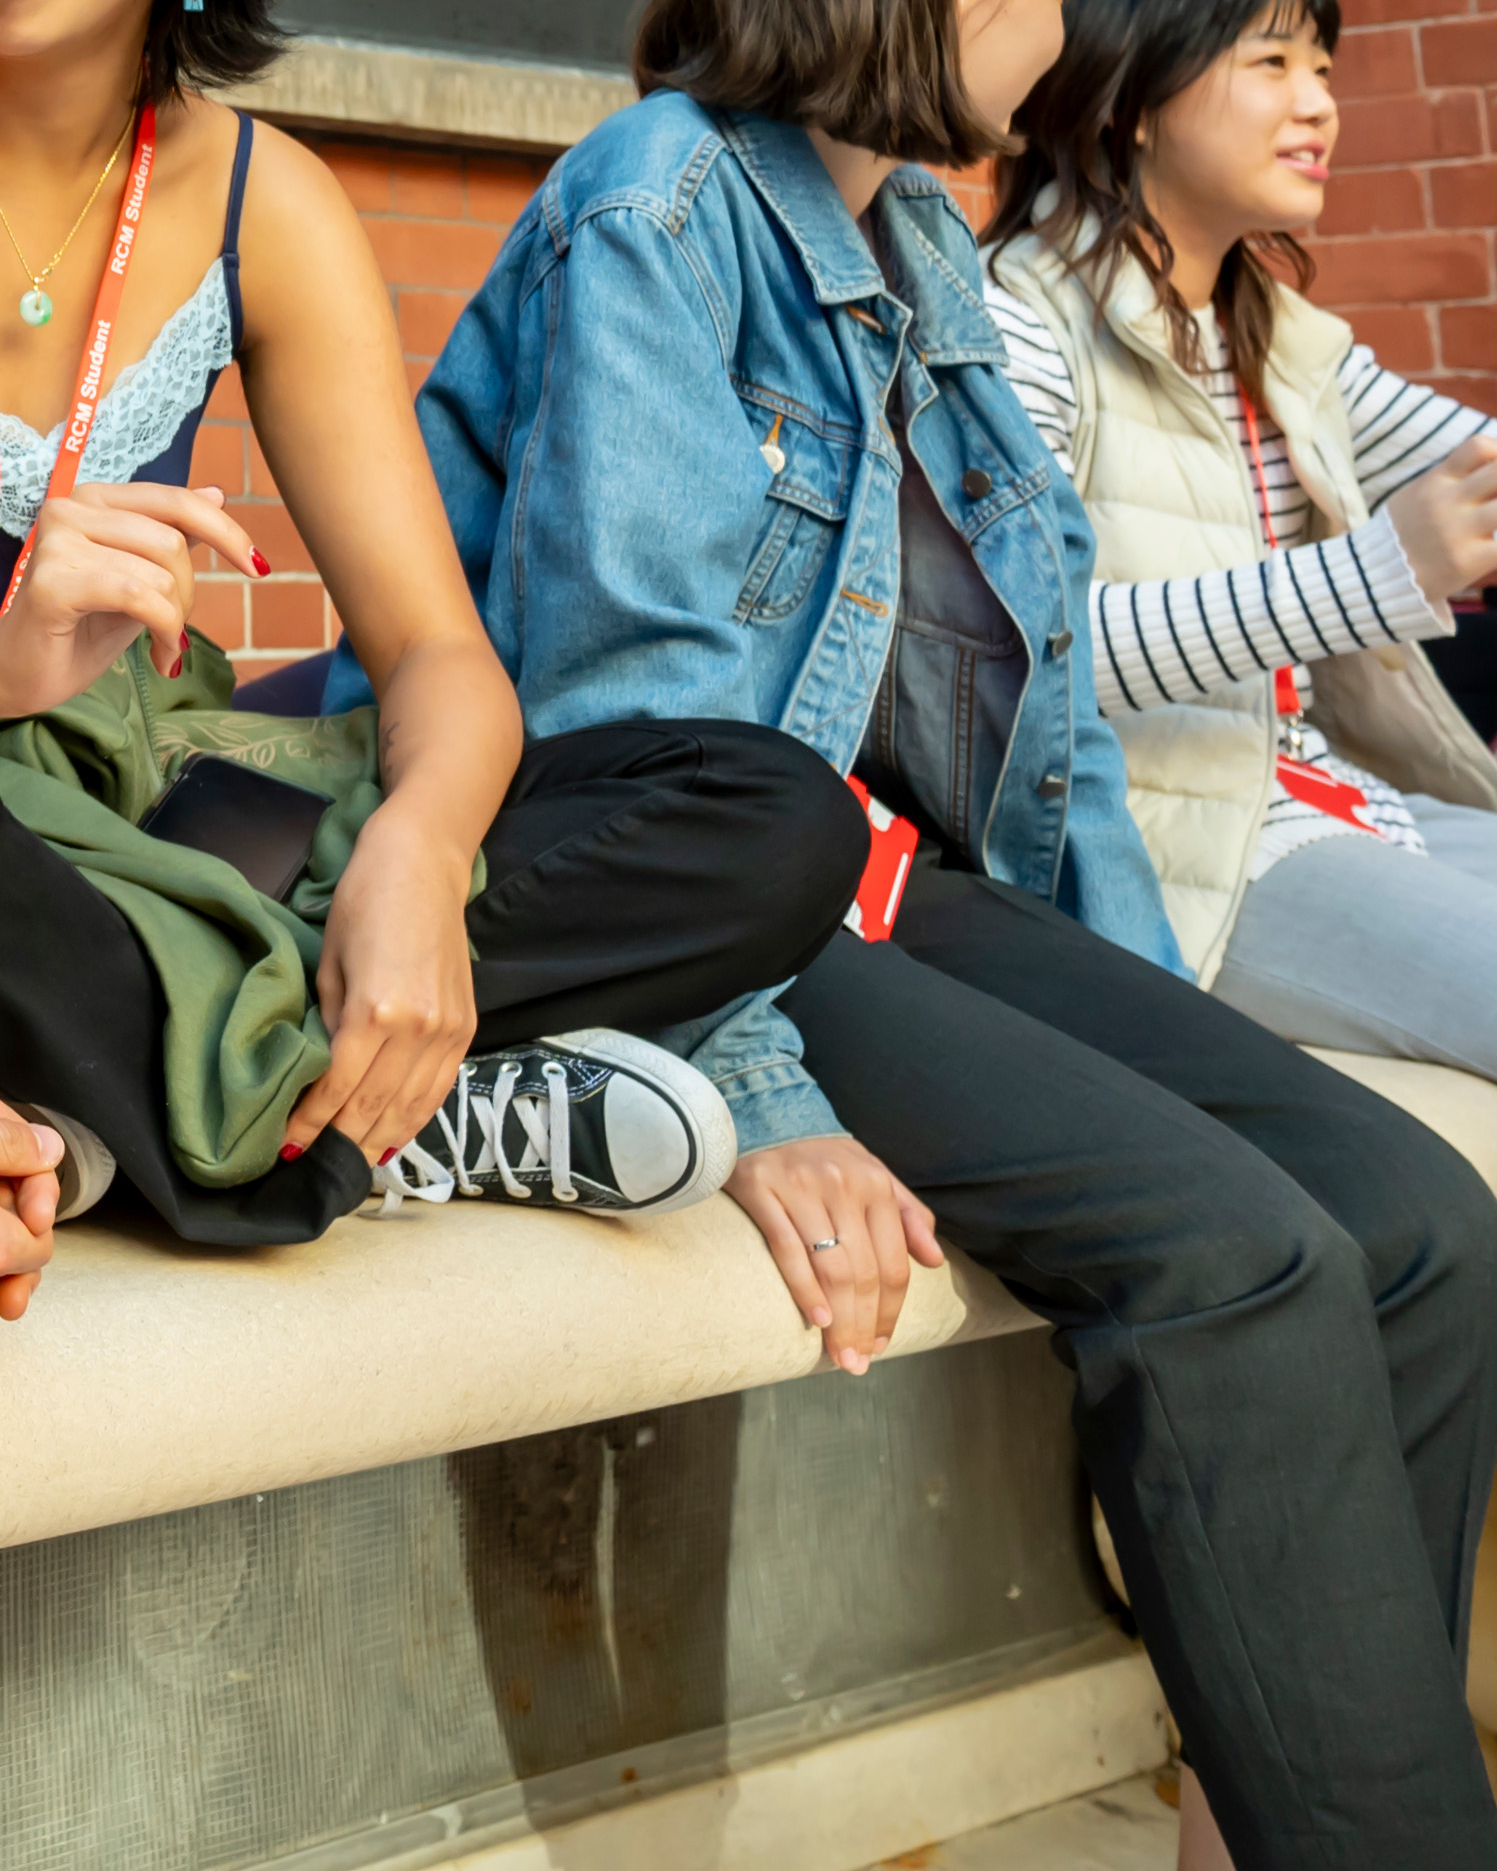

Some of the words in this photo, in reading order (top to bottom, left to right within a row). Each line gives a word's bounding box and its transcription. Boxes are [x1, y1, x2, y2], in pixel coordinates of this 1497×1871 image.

[110, 224, 135, 275] RCM
[125, 143, 153, 222] Student
[65, 404, 93, 453] RCM
[80, 320, 112, 400] Student
